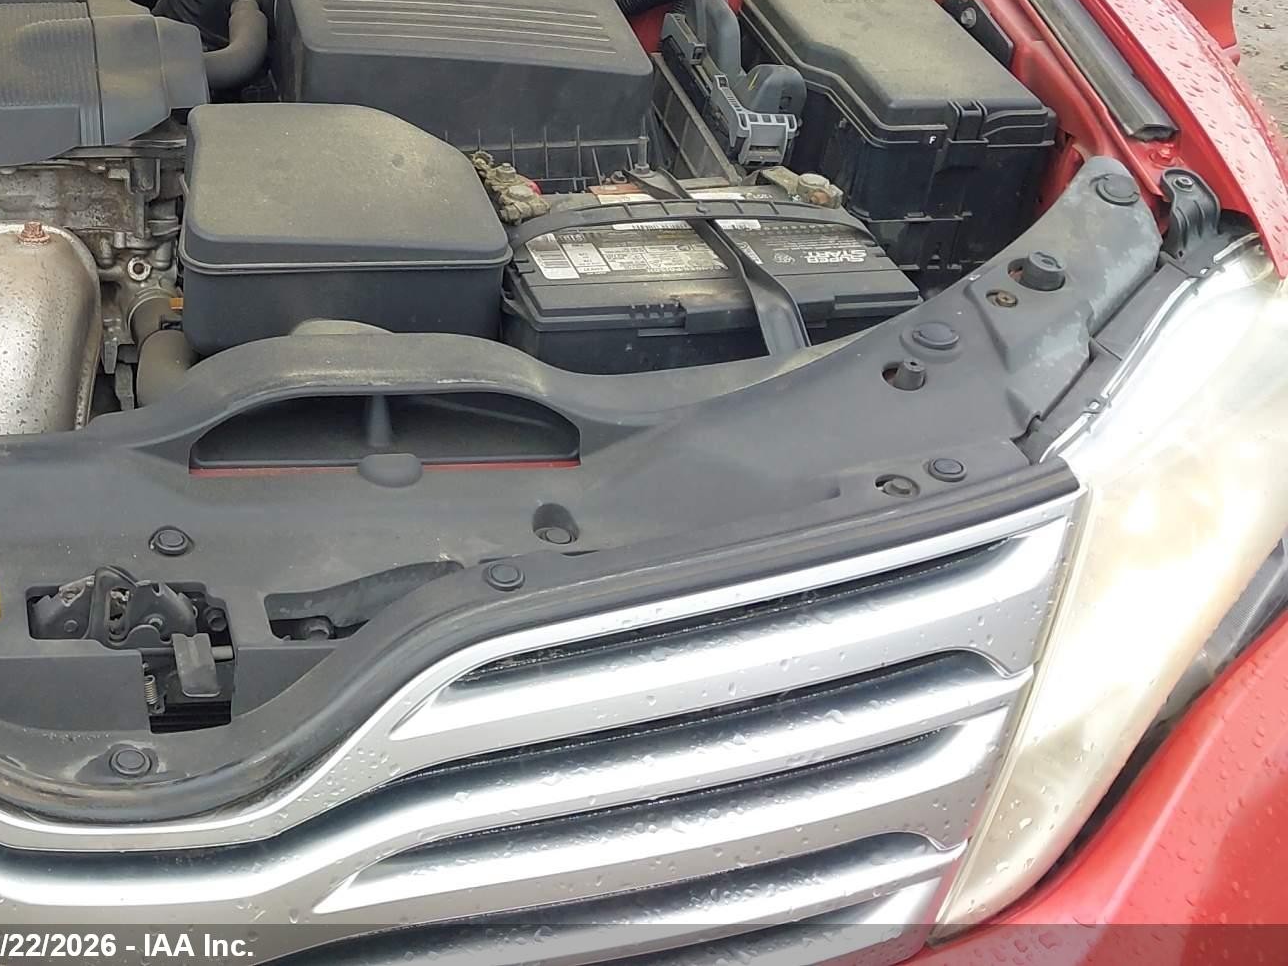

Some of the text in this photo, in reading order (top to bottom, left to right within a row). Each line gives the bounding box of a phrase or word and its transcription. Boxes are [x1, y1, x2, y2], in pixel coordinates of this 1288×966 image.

[929, 135, 937, 144] F
[807, 249, 868, 258] START
[804, 255, 865, 264] SUPER
